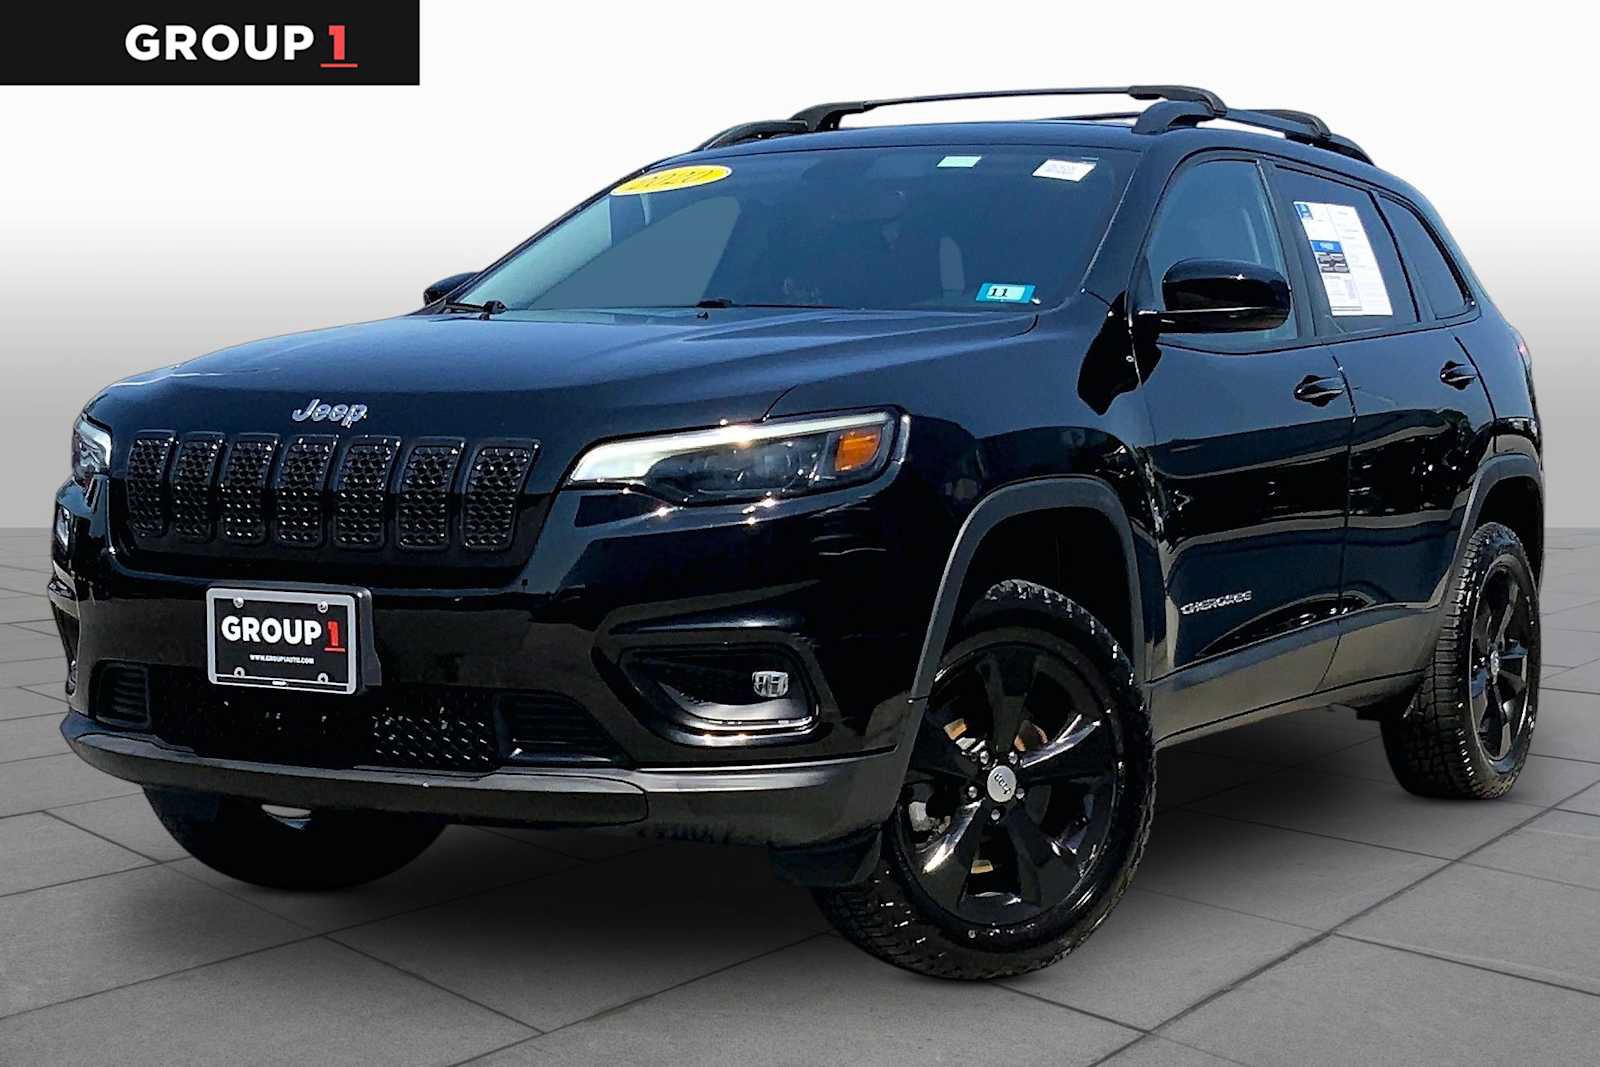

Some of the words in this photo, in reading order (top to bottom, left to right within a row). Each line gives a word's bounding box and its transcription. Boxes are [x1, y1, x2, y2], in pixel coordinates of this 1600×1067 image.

[988, 288, 1008, 297] 11
[292, 398, 368, 428] Jeep
[221, 615, 322, 645] GROUP
[324, 620, 346, 653] 1
